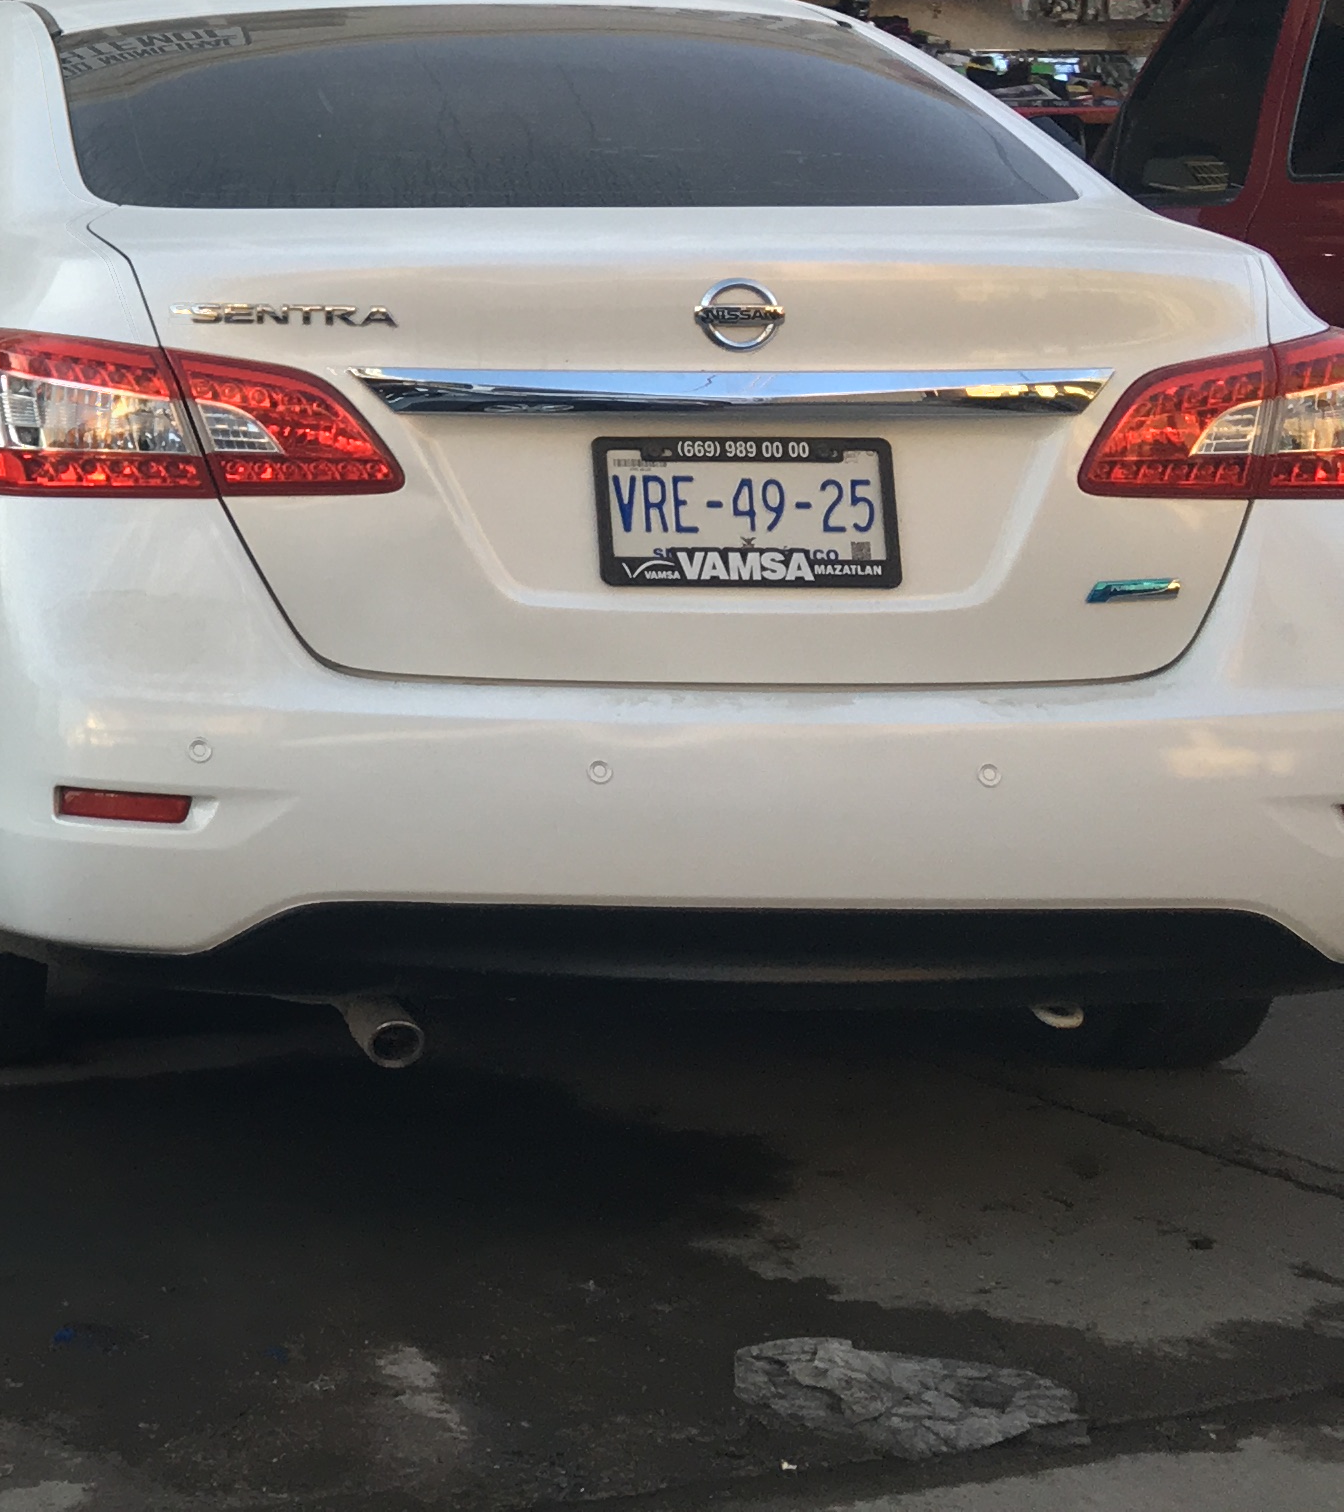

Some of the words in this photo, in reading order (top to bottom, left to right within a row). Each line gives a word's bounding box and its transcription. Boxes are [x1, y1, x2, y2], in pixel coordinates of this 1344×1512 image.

[178, 302, 399, 328] SENTRA
[701, 308, 780, 323] NISSAN
[677, 440, 721, 458] (669)
[726, 441, 757, 457] 989
[762, 441, 783, 457] 00
[788, 441, 809, 458] 00
[612, 474, 875, 533] VRE-49-25
[644, 570, 681, 580] VAMSA
[677, 551, 815, 581] VAMSA
[814, 564, 882, 576] MAZATLAN
